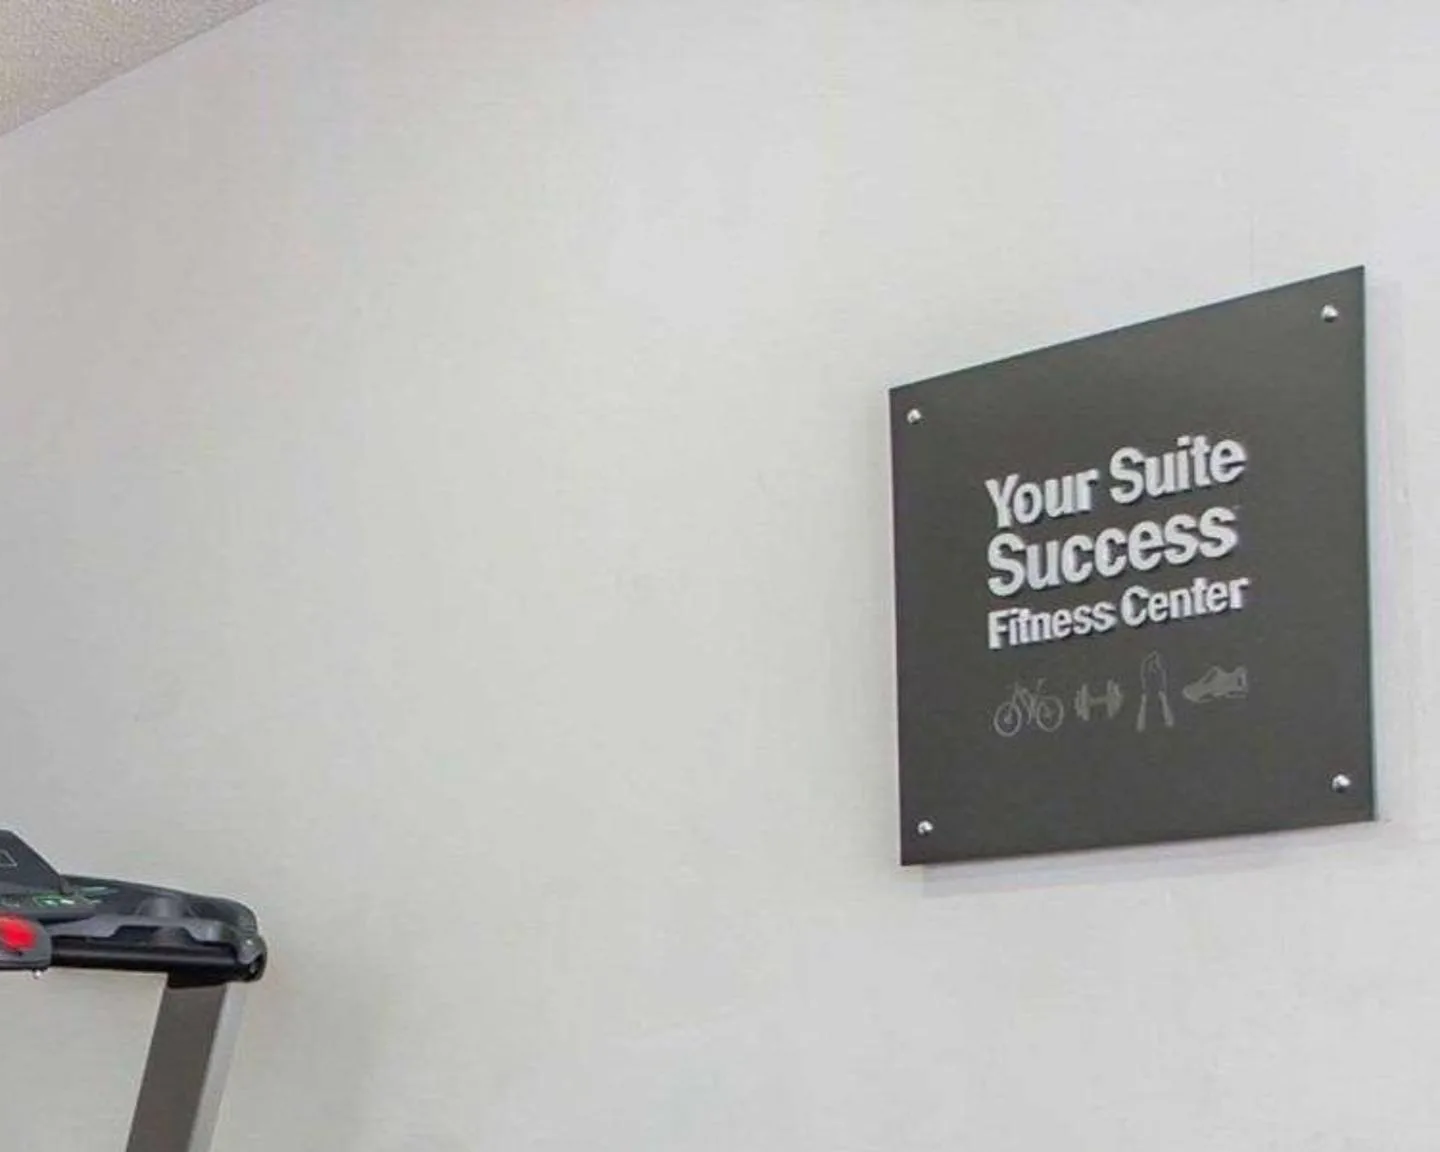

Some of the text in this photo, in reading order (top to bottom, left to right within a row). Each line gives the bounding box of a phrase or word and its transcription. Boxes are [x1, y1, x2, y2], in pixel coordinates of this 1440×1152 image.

[984, 434, 1248, 529] Your Suite
[987, 505, 1239, 597] Success
[988, 576, 1251, 650] Fitness Center
